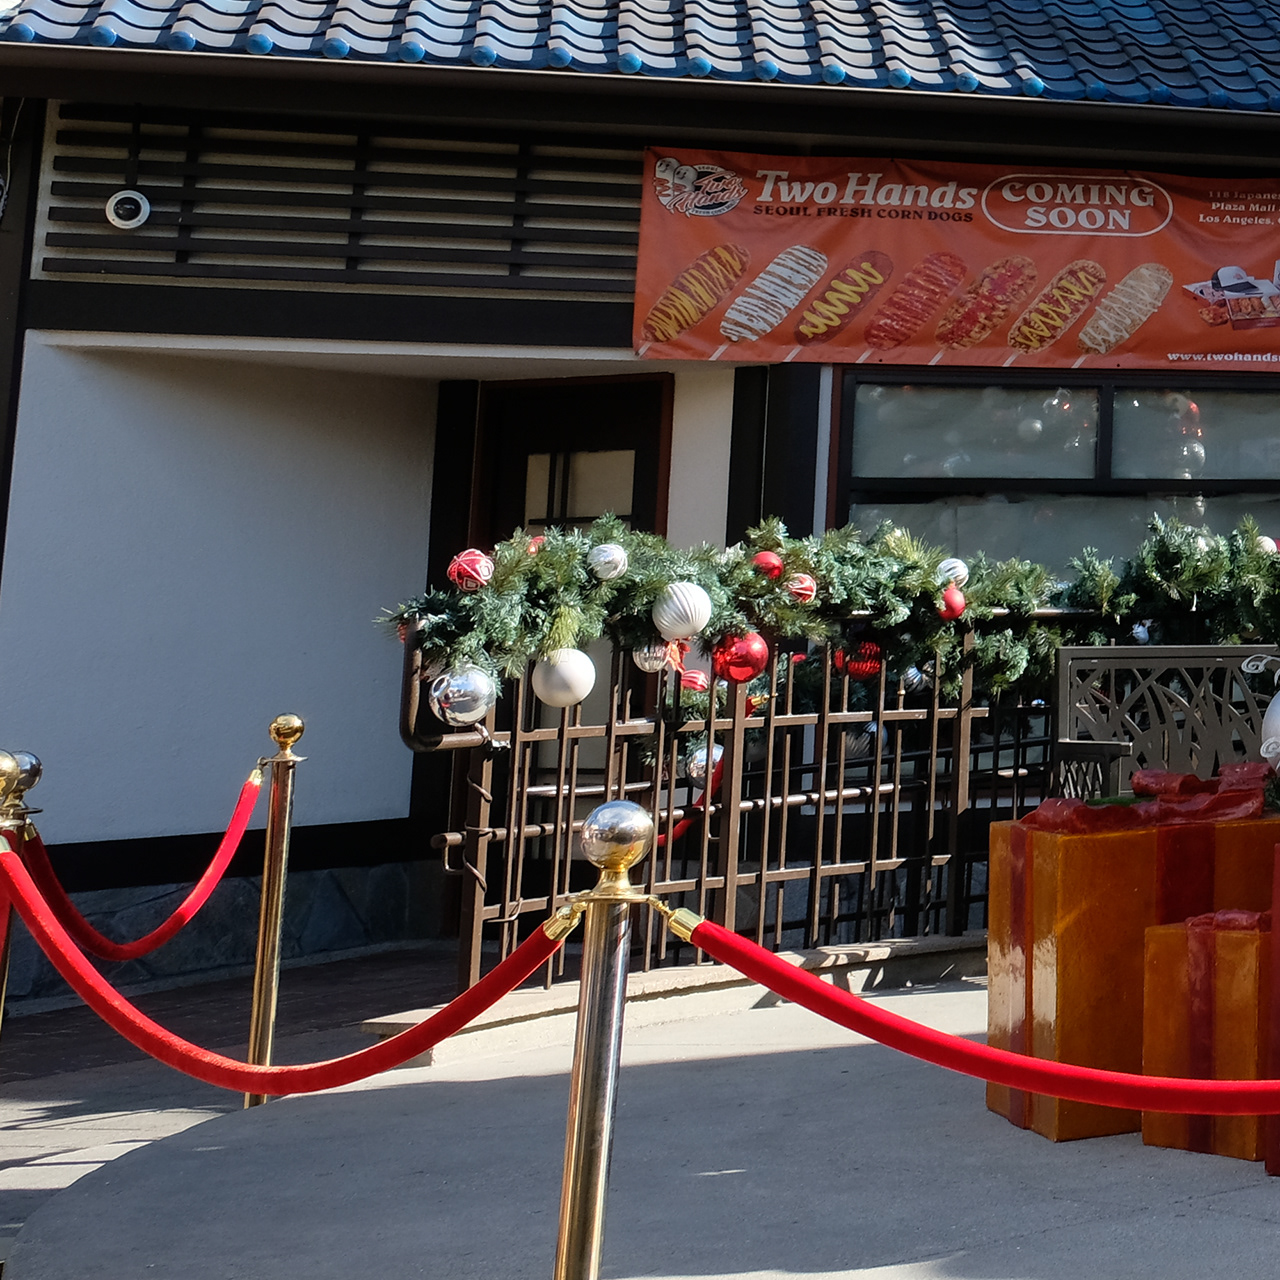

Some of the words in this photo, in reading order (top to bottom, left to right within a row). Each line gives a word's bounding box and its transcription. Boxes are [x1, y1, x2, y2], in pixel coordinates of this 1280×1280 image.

[693, 170, 743, 196] Two
[755, 169, 838, 204] Two
[839, 172, 979, 210] Hands
[1001, 182, 1155, 207] COMING
[666, 184, 749, 213] Hands
[1211, 201, 1246, 211] Plaza
[1249, 203, 1276, 212] Mall
[753, 204, 811, 217] SEOUL
[816, 207, 872, 219] FRESH
[876, 208, 924, 220] CORN
[927, 210, 974, 223] DOGS
[1024, 206, 1132, 230] SOON
[1199, 213, 1220, 224] Los
[1223, 214, 1275, 226] Angeles,
